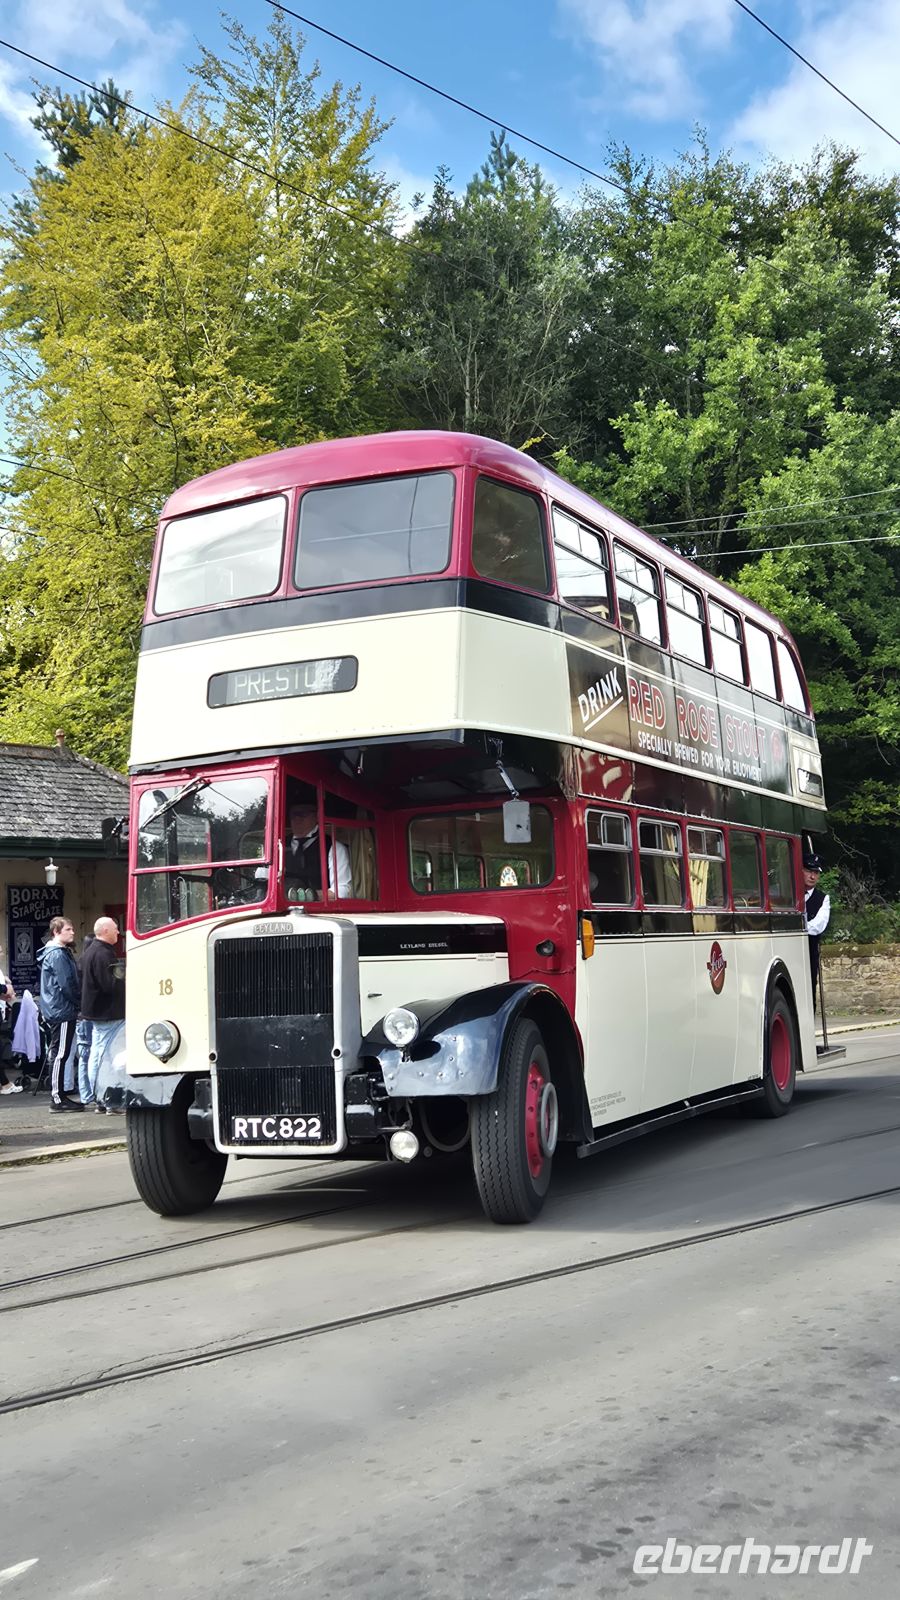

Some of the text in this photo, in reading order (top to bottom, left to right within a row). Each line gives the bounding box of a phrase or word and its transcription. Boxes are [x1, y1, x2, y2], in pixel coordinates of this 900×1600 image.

[577, 667, 623, 723] DRINK
[628, 675, 767, 764] RED ROSE STOUT
[637, 731, 673, 757] SPECIALLY
[701, 750, 715, 769] FOR
[9, 888, 59, 906] BORAX
[12, 901, 45, 919] STARCH
[34, 905, 61, 920] GLAZE
[254, 922, 292, 934] LEYLAND
[159, 978, 173, 996] 18
